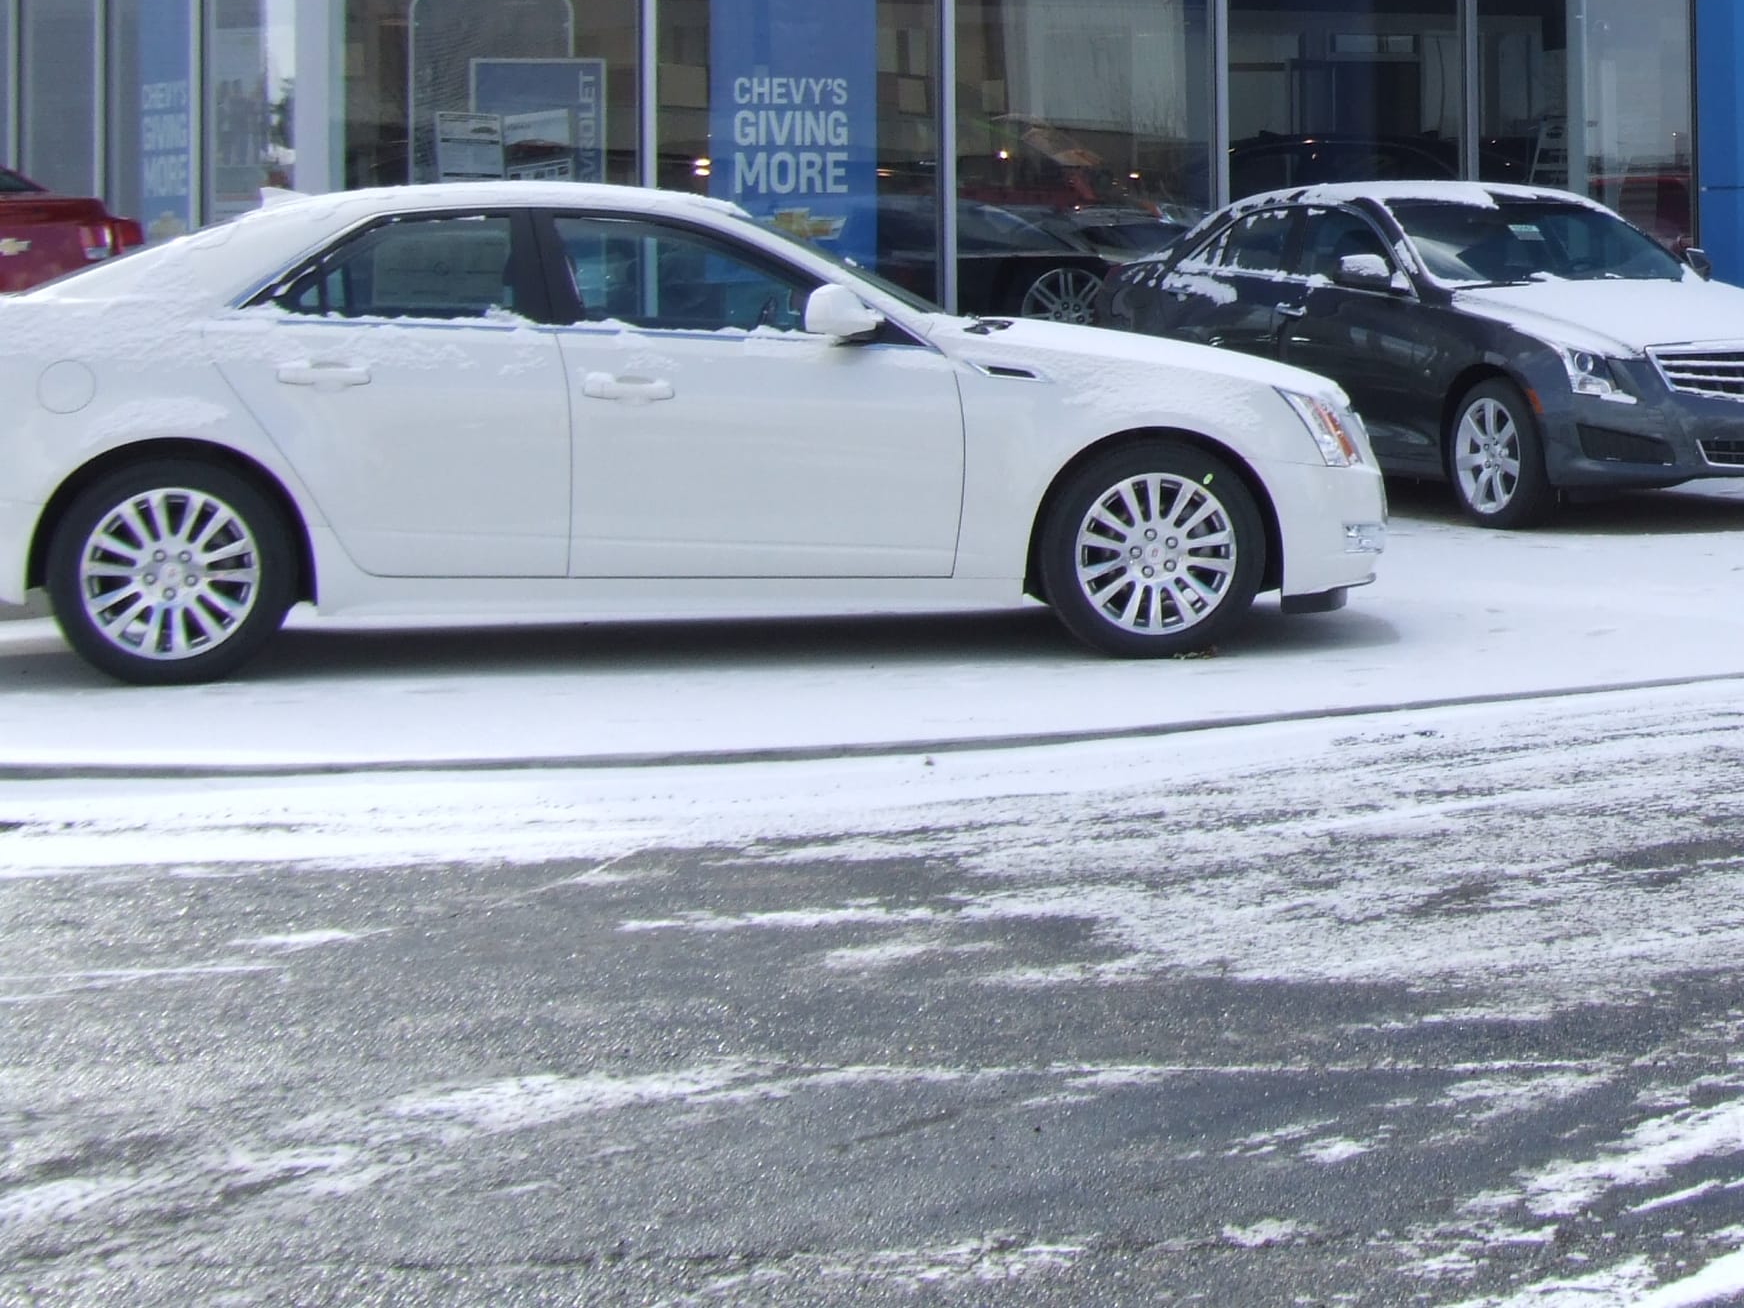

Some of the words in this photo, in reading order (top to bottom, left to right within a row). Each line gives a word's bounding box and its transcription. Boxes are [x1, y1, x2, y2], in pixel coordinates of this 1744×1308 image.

[734, 77, 848, 105] CHEVY'S
[734, 110, 849, 146] GIVING
[734, 151, 849, 194] MORE
